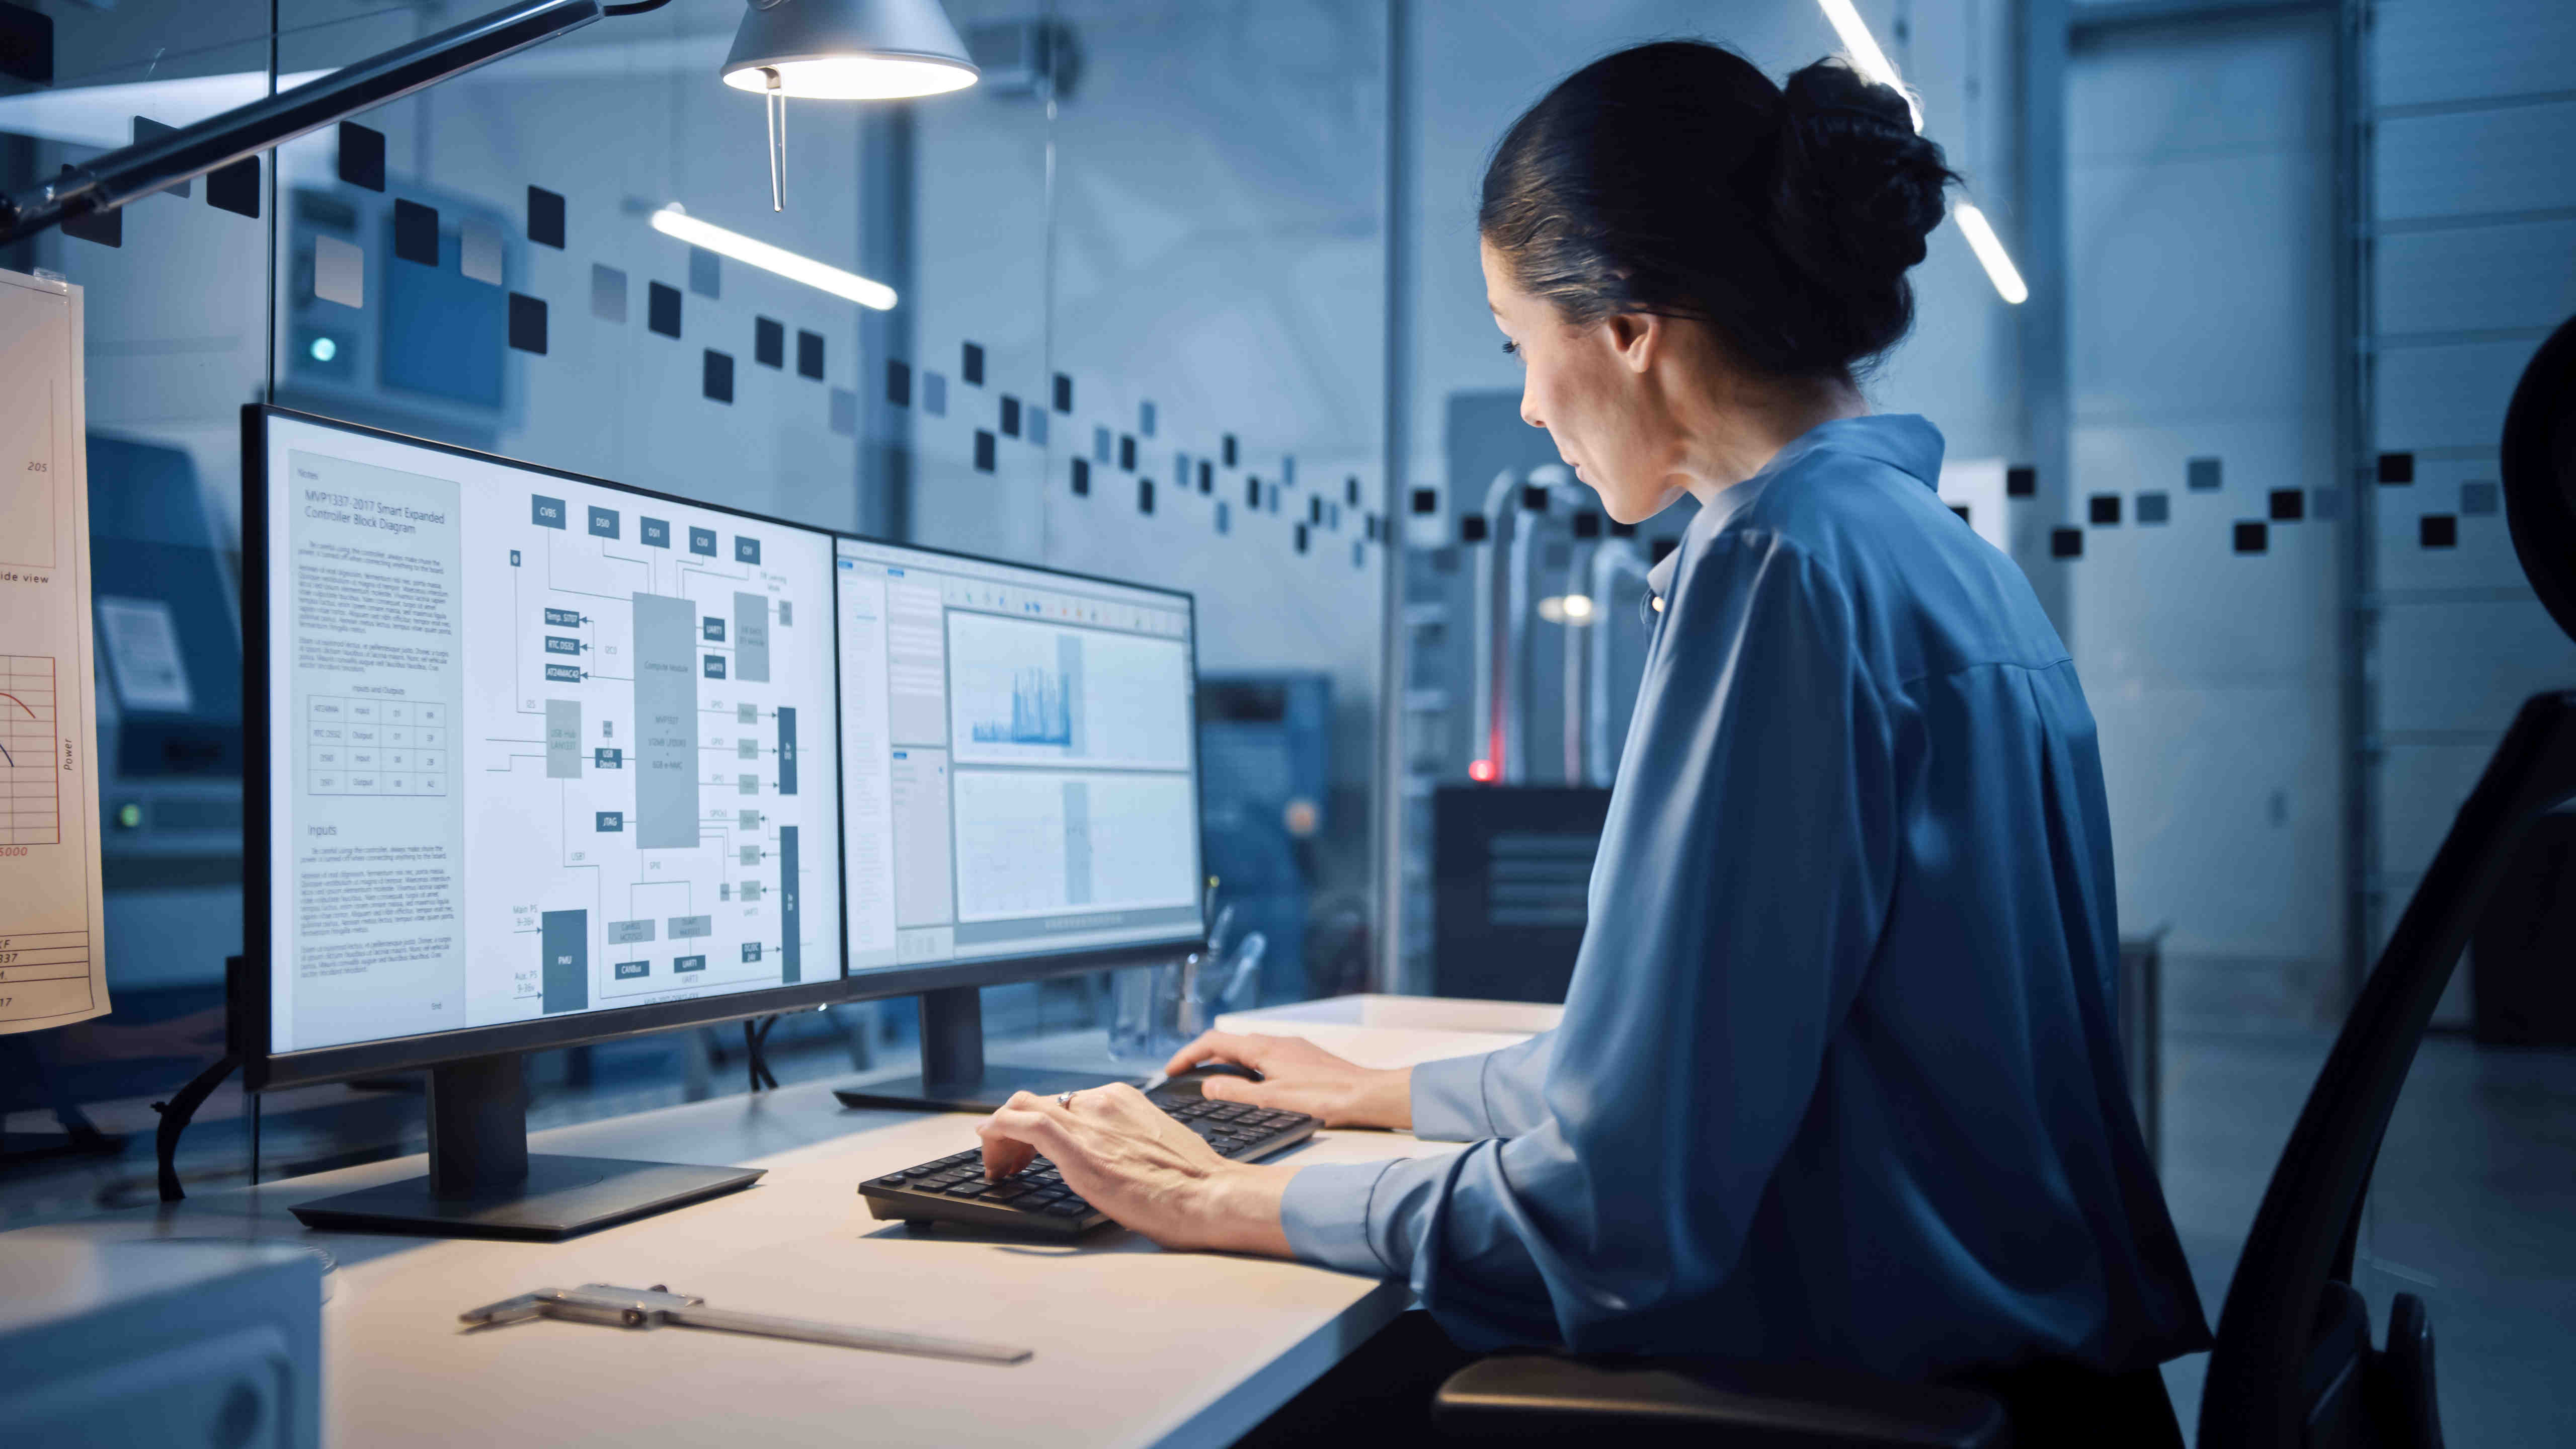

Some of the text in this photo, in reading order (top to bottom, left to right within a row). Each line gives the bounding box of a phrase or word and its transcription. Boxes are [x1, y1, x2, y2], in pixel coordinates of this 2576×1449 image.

[28, 461, 47, 472] 205
[377, 502, 401, 517] Smart
[405, 507, 445, 524] Expanded
[540, 507, 556, 518] CVBS
[305, 505, 416, 535] Controller Block Diagram
[23, 574, 49, 583] view
[63, 739, 73, 771] Power
[603, 817, 617, 827] JTAG
[307, 825, 337, 839] Inputs
[558, 955, 572, 965] PMU
